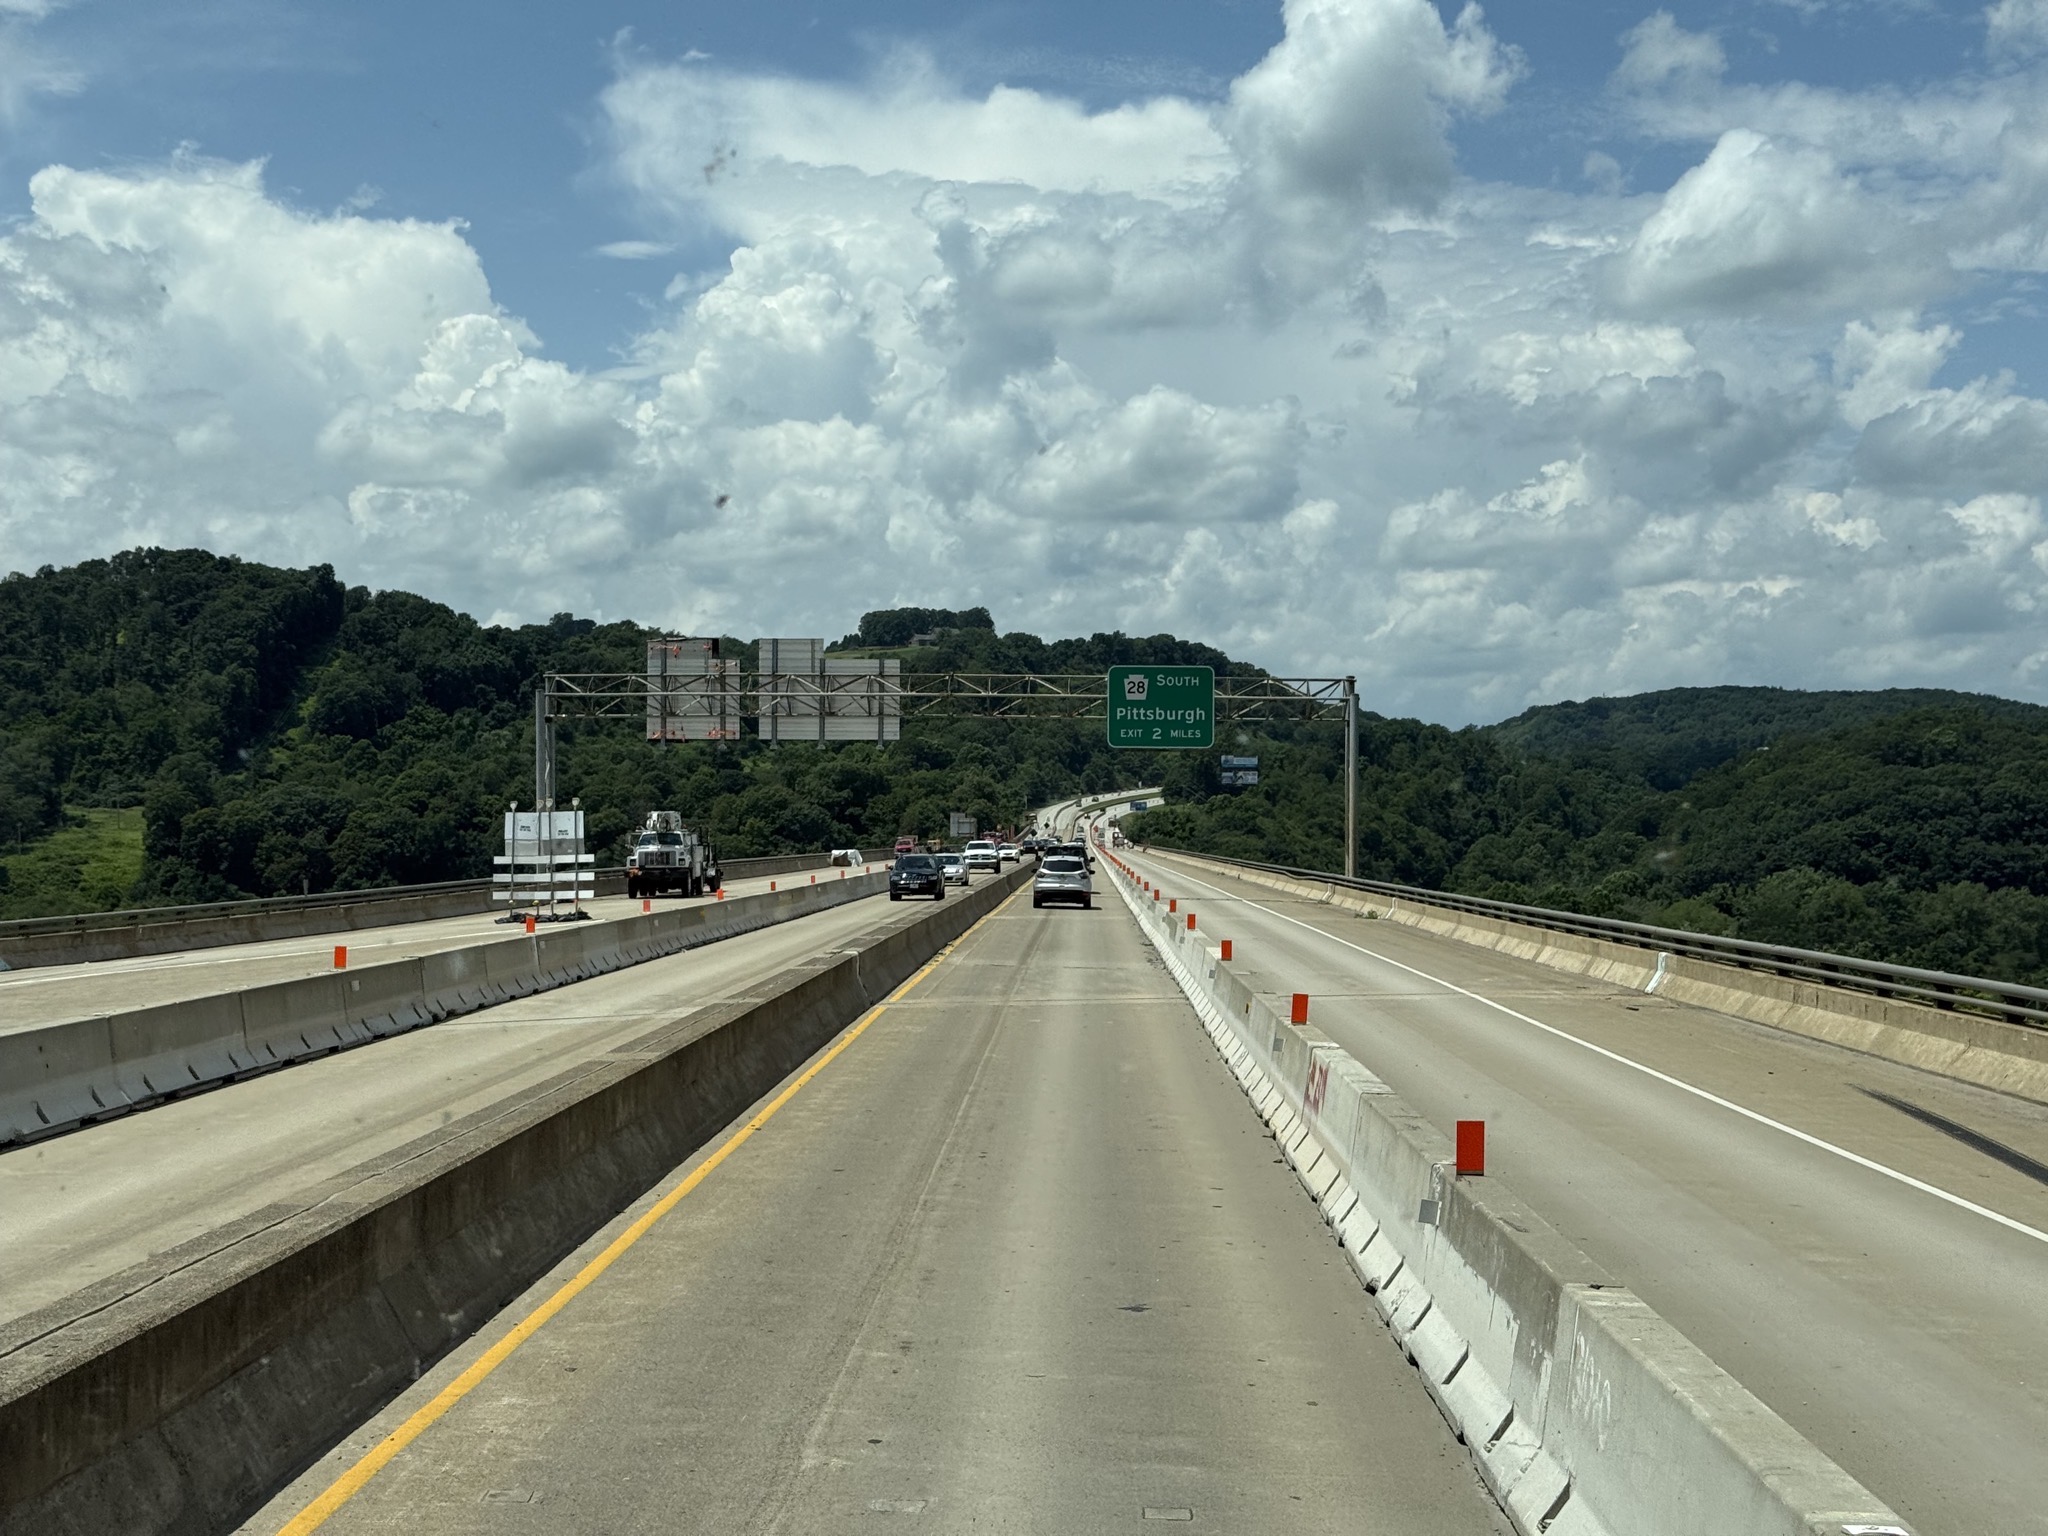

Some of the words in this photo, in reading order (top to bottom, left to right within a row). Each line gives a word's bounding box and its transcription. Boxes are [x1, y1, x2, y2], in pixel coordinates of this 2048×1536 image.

[1156, 674, 1199, 686] SOUTH
[1127, 681, 1145, 694] 28
[1116, 707, 1205, 724] Pittsburgh
[1120, 729, 1143, 738] EXIT
[1152, 728, 1161, 739] 2
[1170, 730, 1201, 738] MILES
